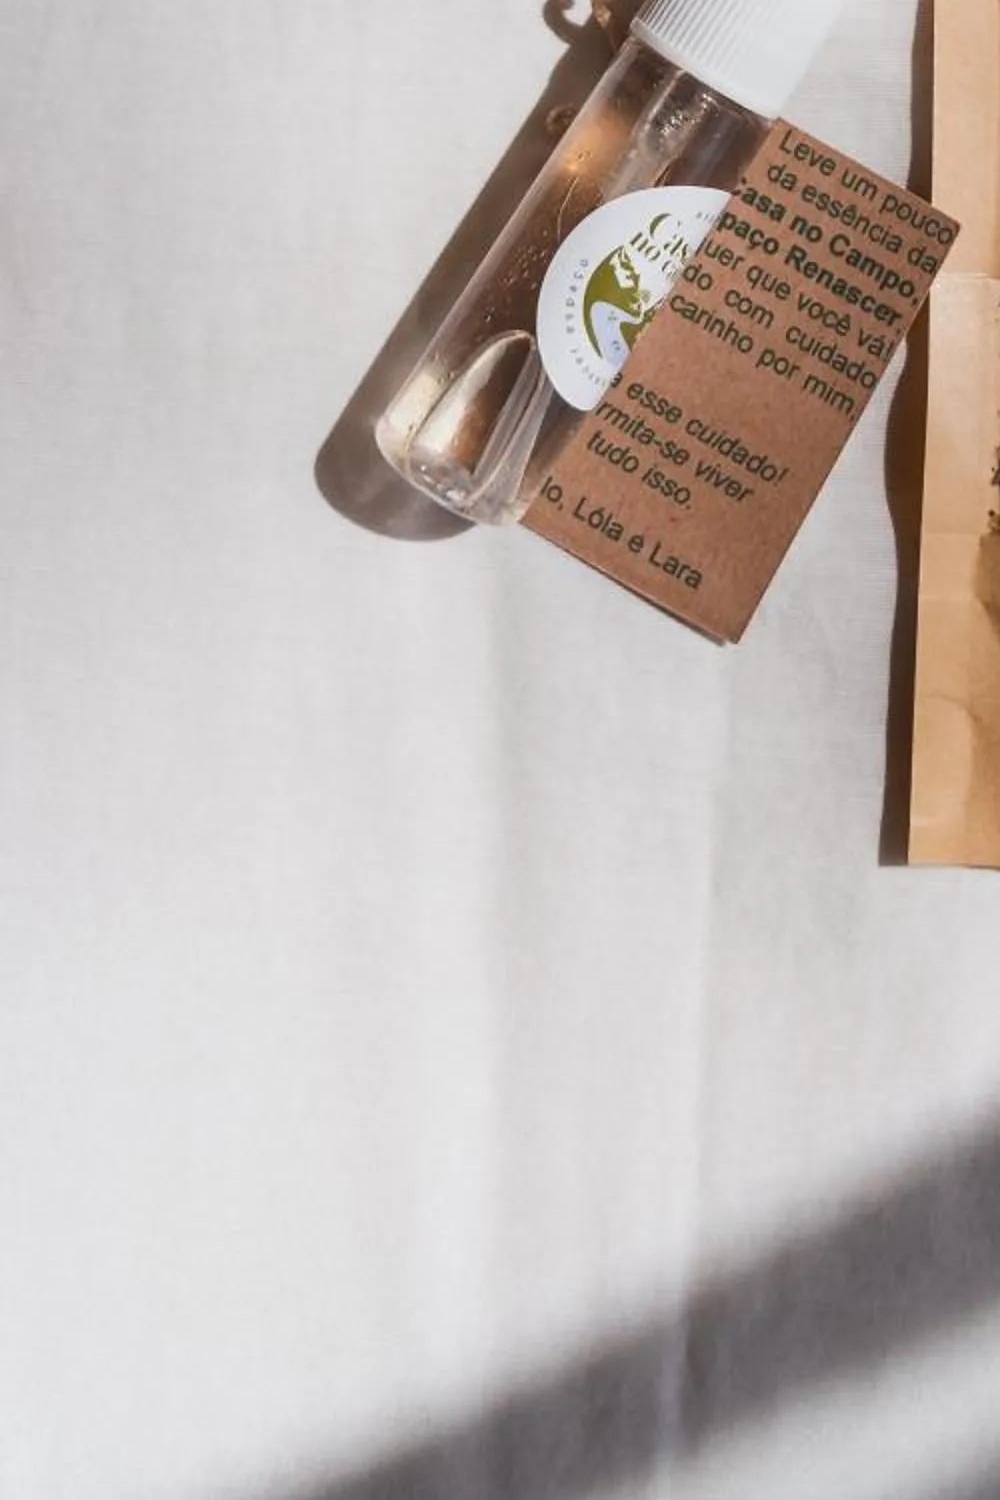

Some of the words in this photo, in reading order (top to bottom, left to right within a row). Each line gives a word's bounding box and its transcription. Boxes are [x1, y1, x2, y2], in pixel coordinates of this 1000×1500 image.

[768, 164, 797, 192] da
[802, 185, 902, 254] essência
[908, 247, 941, 280] da
[779, 129, 836, 176] Leve
[841, 168, 878, 201] um
[879, 188, 957, 249] pouco
[629, 231, 662, 263] no
[789, 215, 822, 243] no
[669, 292, 755, 354] carinho
[756, 349, 800, 379] por
[746, 265, 790, 300] que
[798, 293, 850, 336] você
[724, 290, 774, 329] com
[786, 326, 882, 395] cuidado
[587, 430, 639, 473] tudo
[642, 468, 690, 509] isso.
[627, 383, 682, 423] esse
[686, 420, 788, 481] cuidado!
[695, 461, 753, 501] viver
[628, 536, 644, 553] e
[649, 542, 702, 589] Lara
